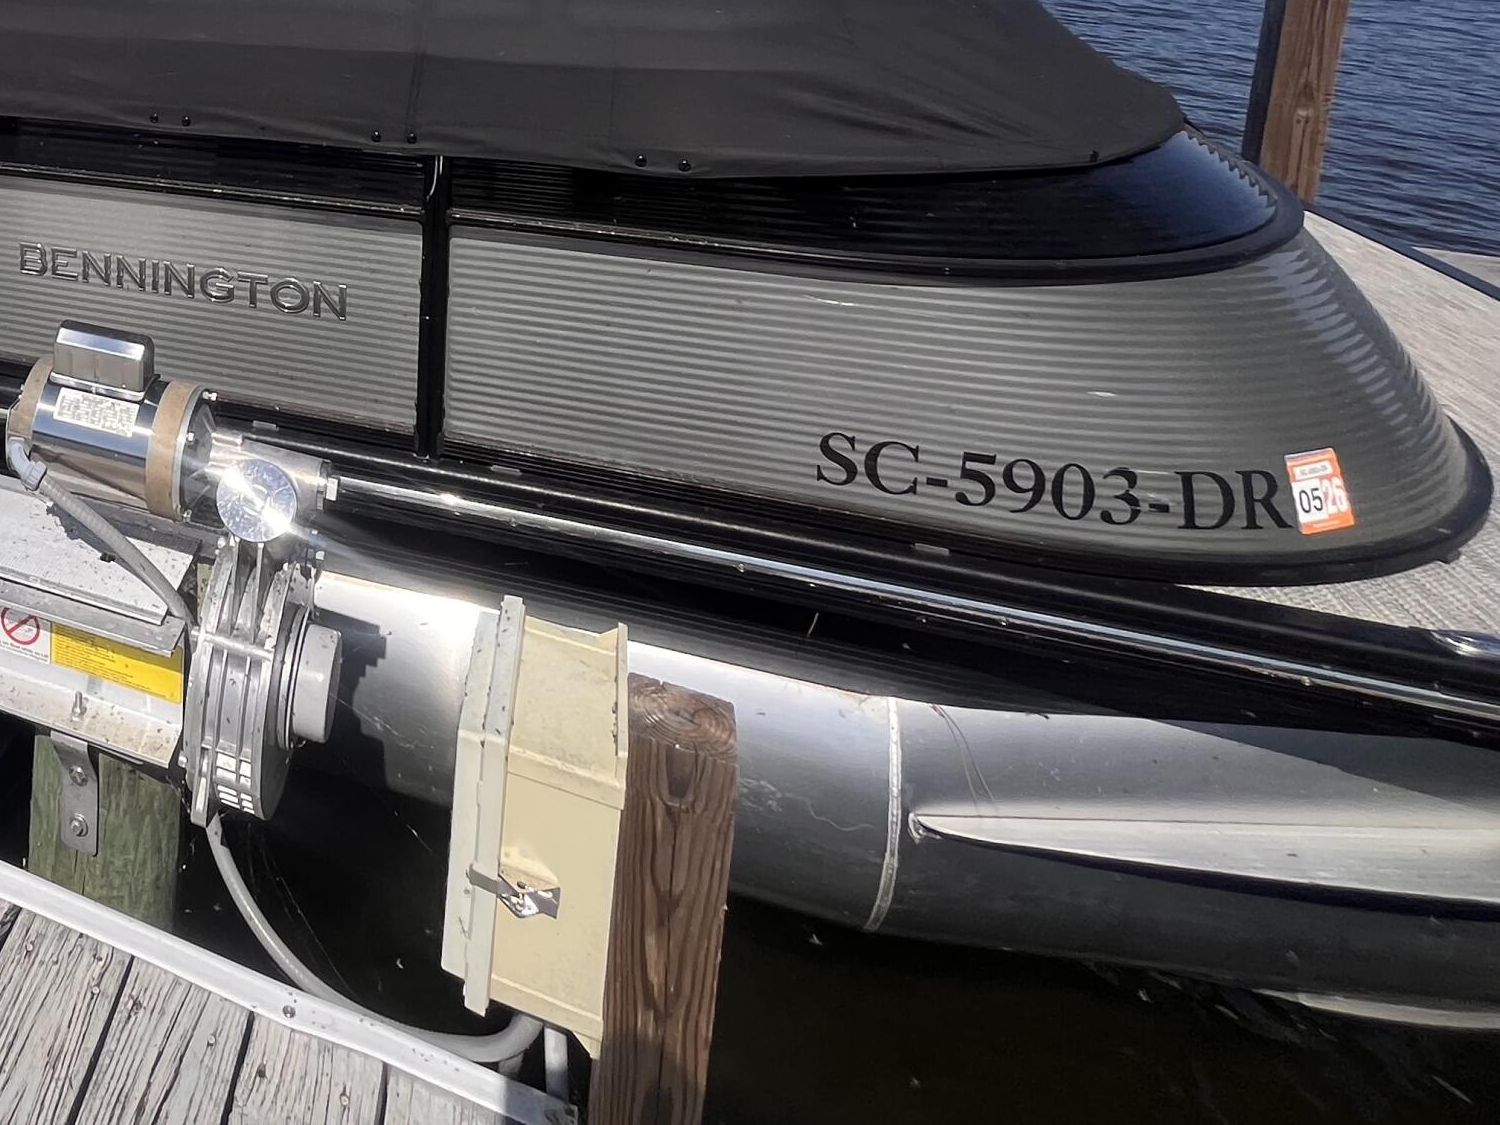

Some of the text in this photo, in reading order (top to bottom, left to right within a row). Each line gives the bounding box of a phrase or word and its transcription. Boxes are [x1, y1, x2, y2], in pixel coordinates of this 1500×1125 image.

[18, 240, 348, 321] BENNINGTON
[815, 431, 1294, 530] SC-5903-DR
[1298, 476, 1350, 515] 05 26
